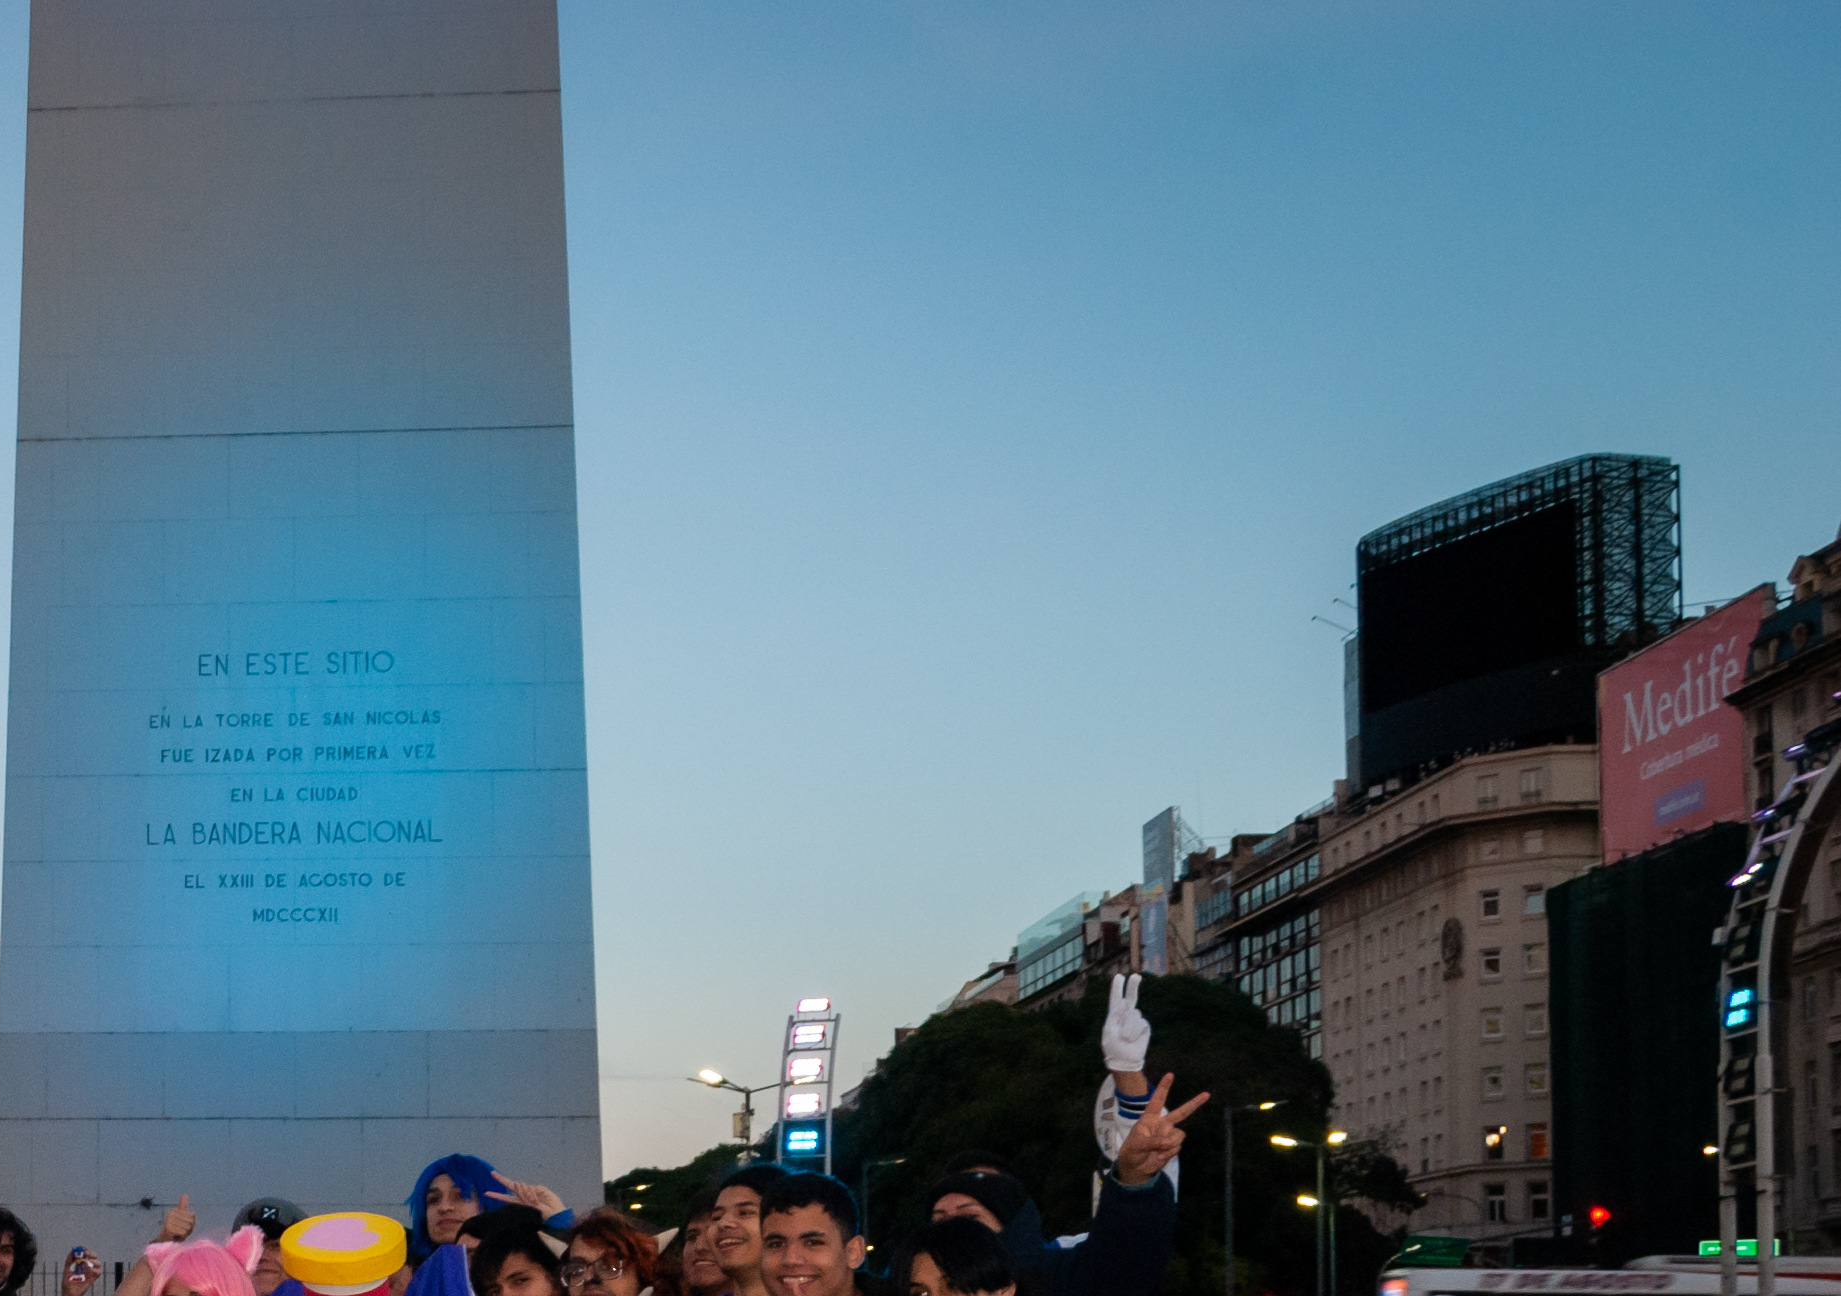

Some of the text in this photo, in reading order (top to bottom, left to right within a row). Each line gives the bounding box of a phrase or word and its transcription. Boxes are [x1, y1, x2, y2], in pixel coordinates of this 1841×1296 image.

[198, 650, 395, 676] EN ESTE SITIO
[1621, 635, 1741, 754] Medifé
[149, 709, 441, 729] EN LA TORRE DE SAN NICOLAS
[160, 744, 436, 763] FUE IZADA POR PRIMERA VEZ
[230, 786, 358, 802] EN LA CIUDAD
[146, 820, 443, 846] LA BANDERA NACIONAL
[184, 871, 406, 889] EL XXIII DE AGOSTO DE
[252, 907, 339, 923] MDCCCXII
